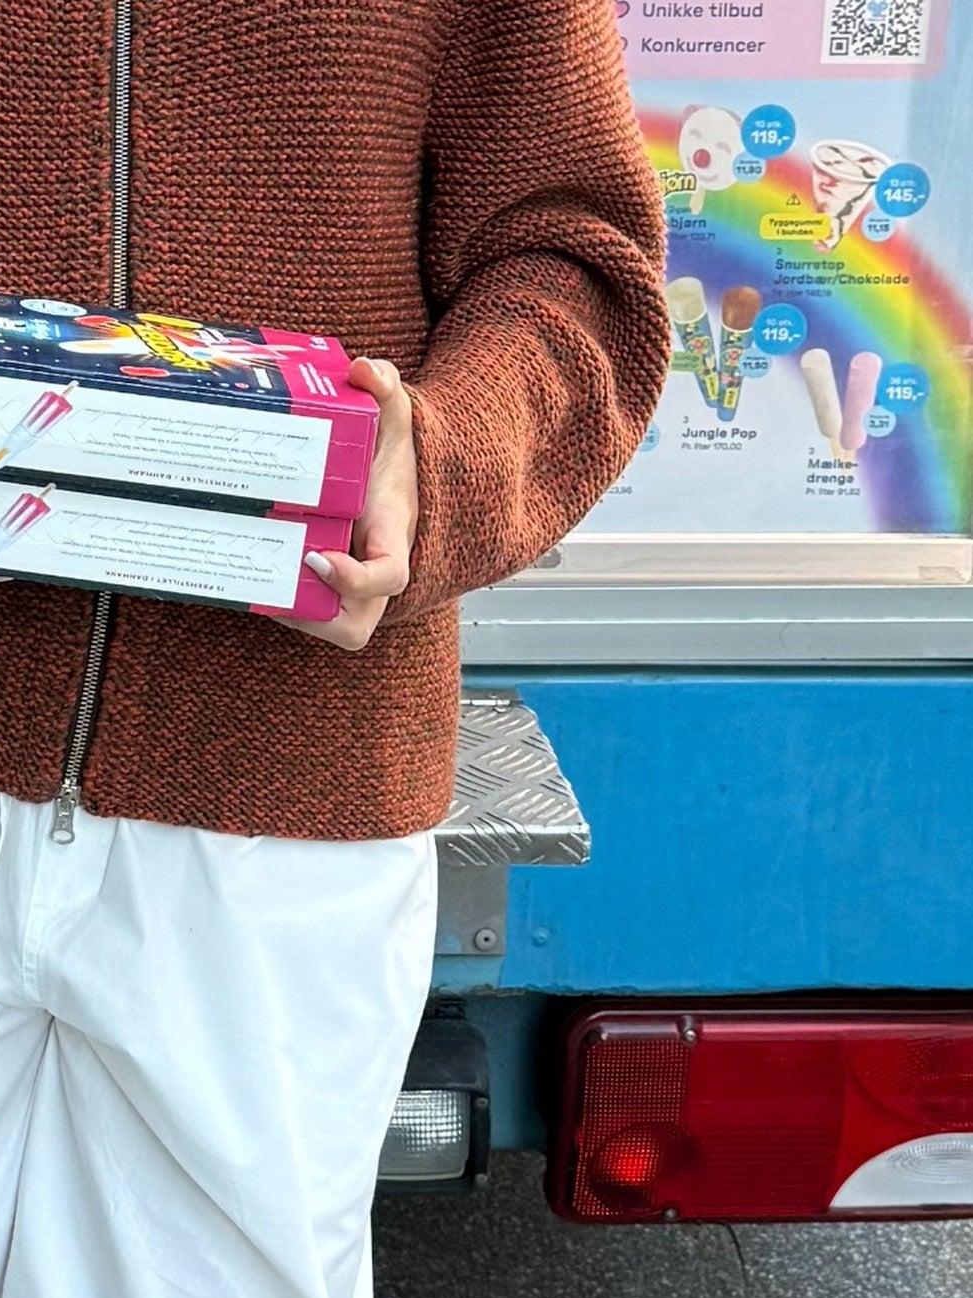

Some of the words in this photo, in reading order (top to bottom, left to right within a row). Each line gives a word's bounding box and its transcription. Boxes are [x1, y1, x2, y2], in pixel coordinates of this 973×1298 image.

[642, 3, 704, 18] Unikke
[709, 2, 763, 18] tilbud
[641, 37, 766, 53] Konkurrencer
[750, 130, 790, 146] 119,-
[883, 188, 925, 203] 145,-
[775, 259, 845, 271] Snurretop
[762, 328, 801, 342] 119,-
[885, 386, 926, 402] 119,-
[682, 428, 727, 440] Jungle
[731, 428, 757, 440] Pop
[807, 474, 854, 486] drenge
